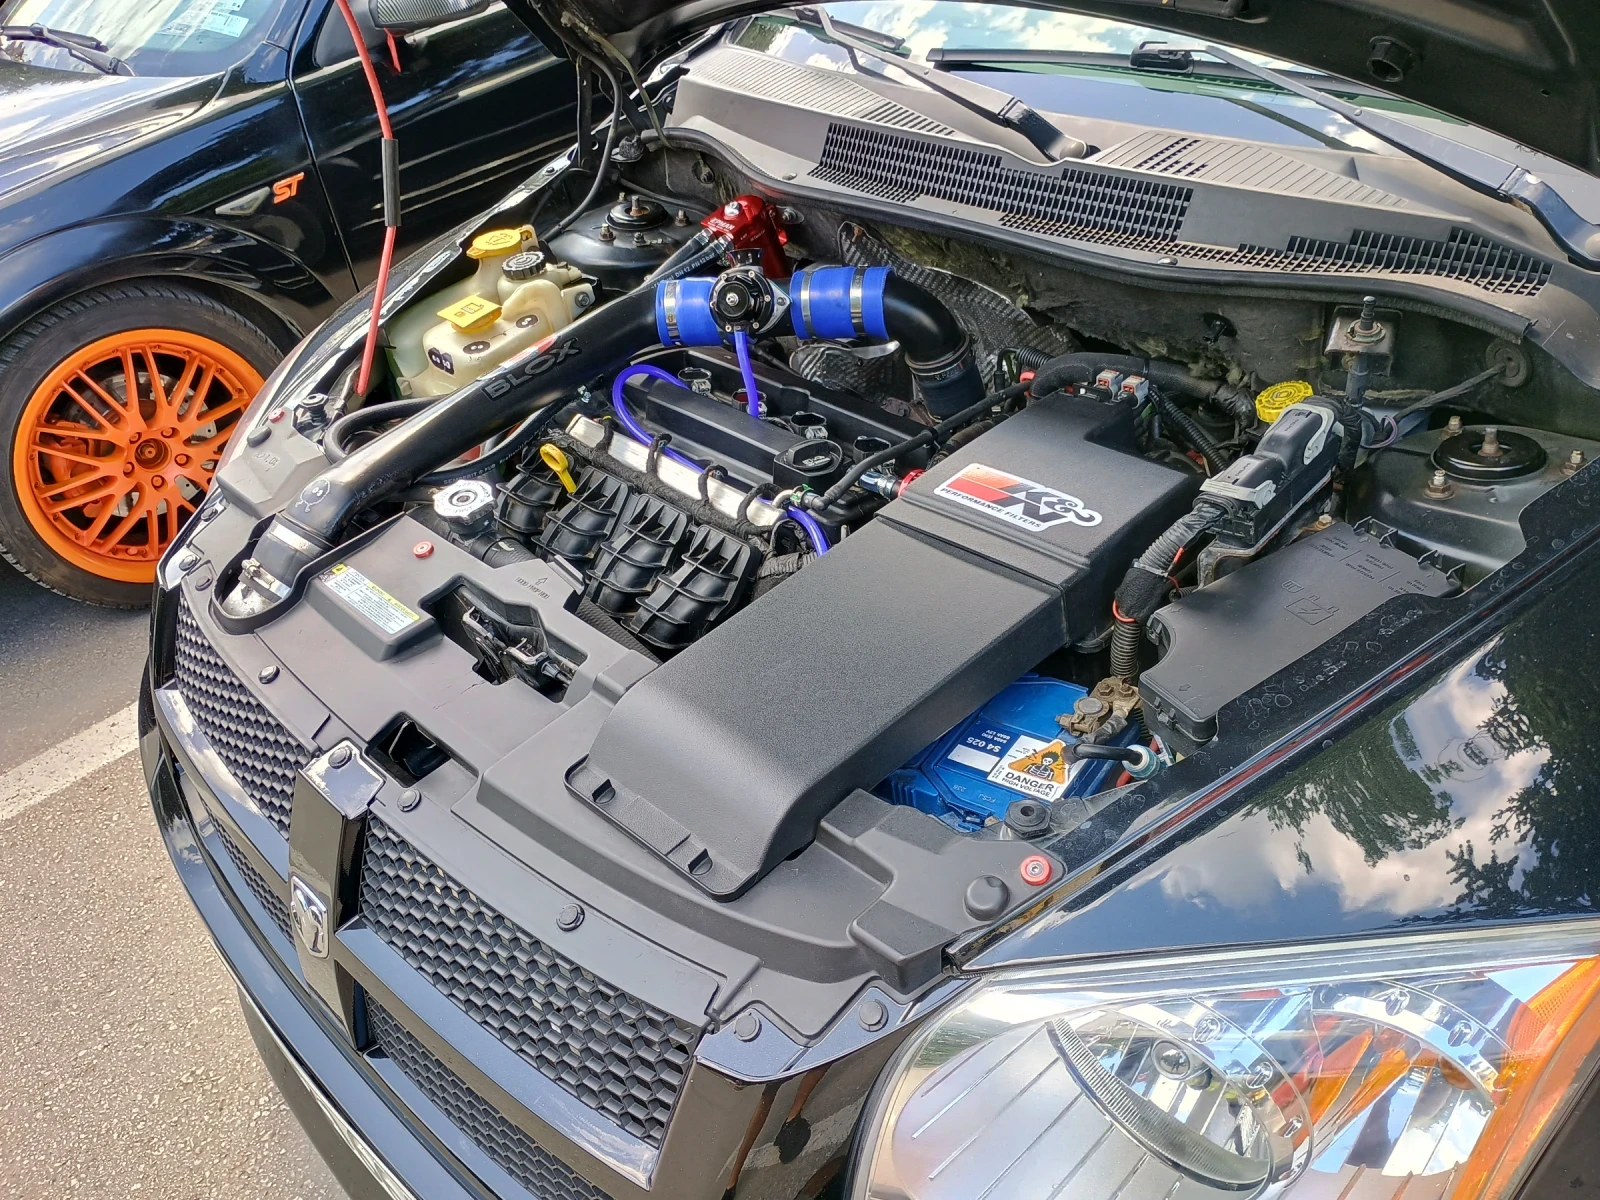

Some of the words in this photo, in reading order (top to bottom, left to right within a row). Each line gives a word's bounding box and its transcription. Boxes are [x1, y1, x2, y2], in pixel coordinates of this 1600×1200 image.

[273, 172, 305, 203] ST
[709, 218, 735, 231] EPMAN
[481, 337, 581, 400] BLOX
[940, 487, 1004, 515] PERFORMANCE
[1005, 511, 1042, 529] FILTERS
[966, 737, 986, 748] 025
[986, 743, 1002, 753] S4
[1001, 778, 1019, 788] HIGH
[1020, 784, 1052, 798] VOLTAGE
[1005, 771, 1055, 793] DANGER
